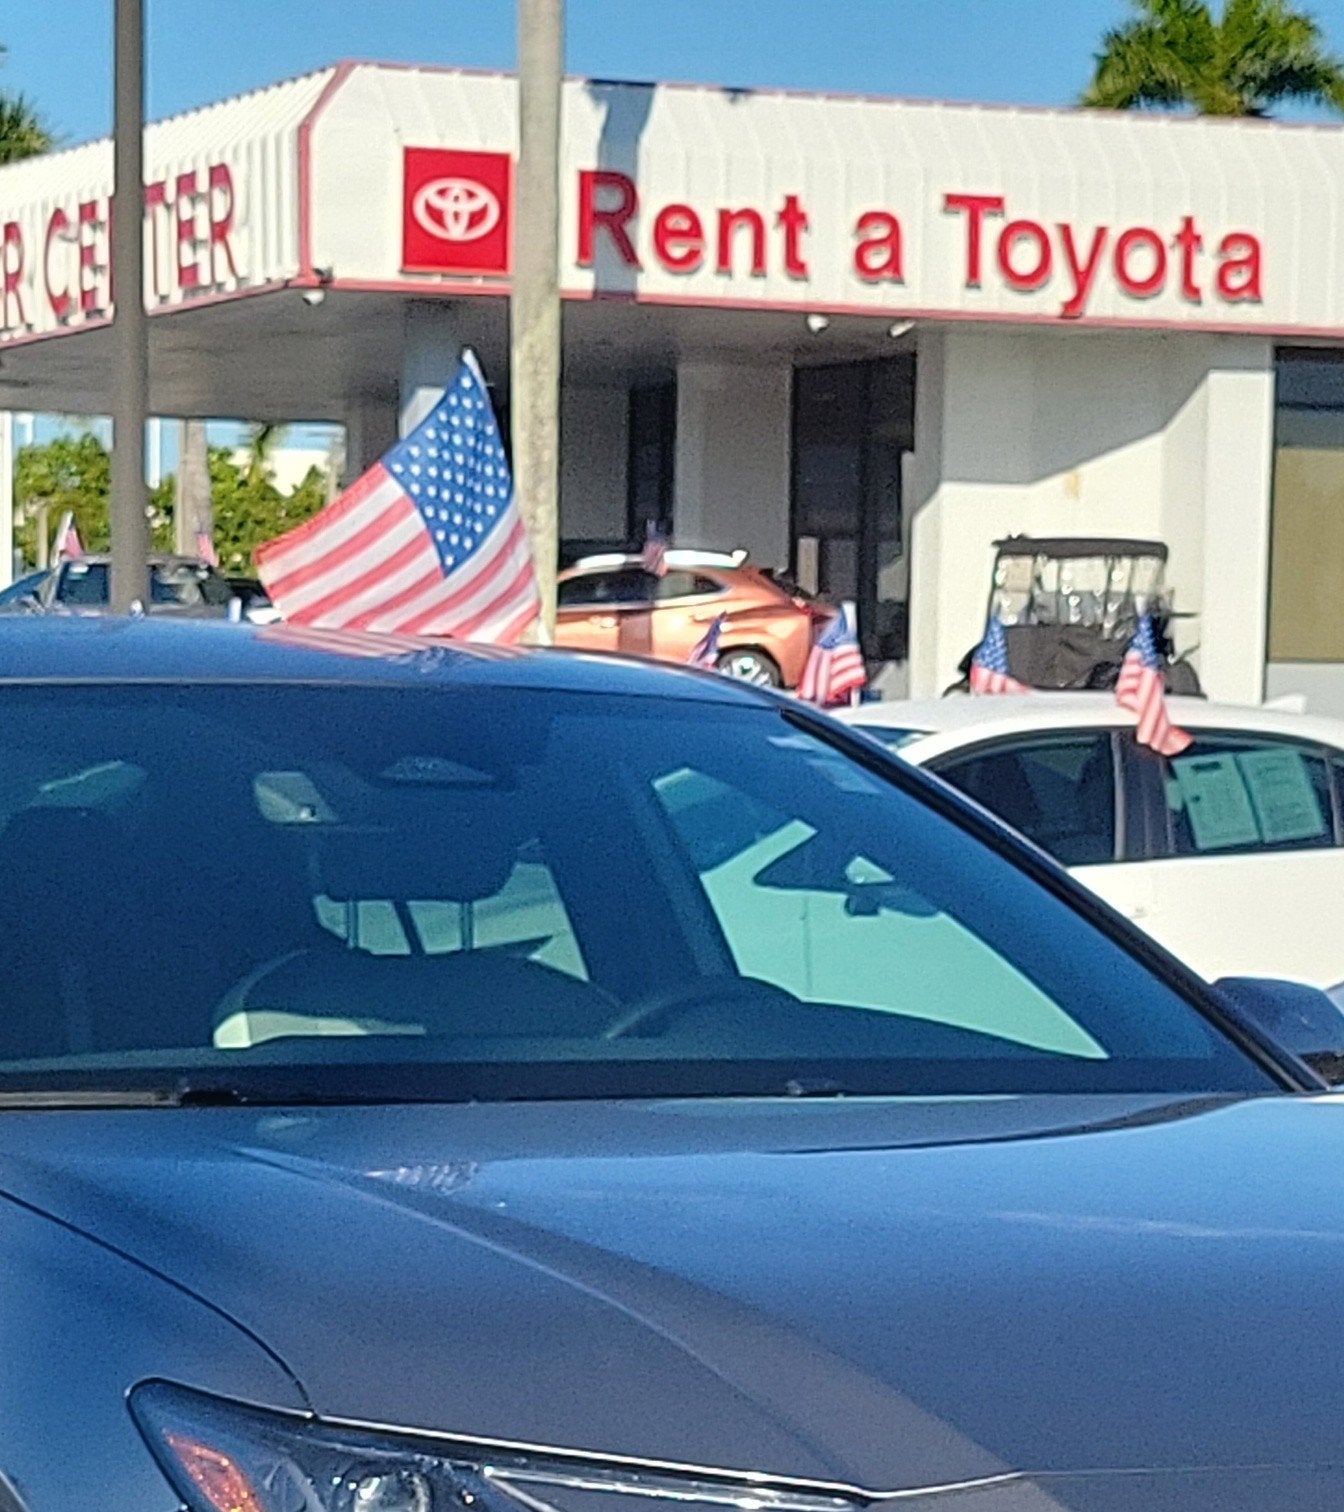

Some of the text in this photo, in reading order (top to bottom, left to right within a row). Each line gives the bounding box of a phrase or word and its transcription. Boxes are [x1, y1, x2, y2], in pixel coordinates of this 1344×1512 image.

[43, 162, 241, 317] CETER
[575, 169, 1263, 320] Rent a Toyota
